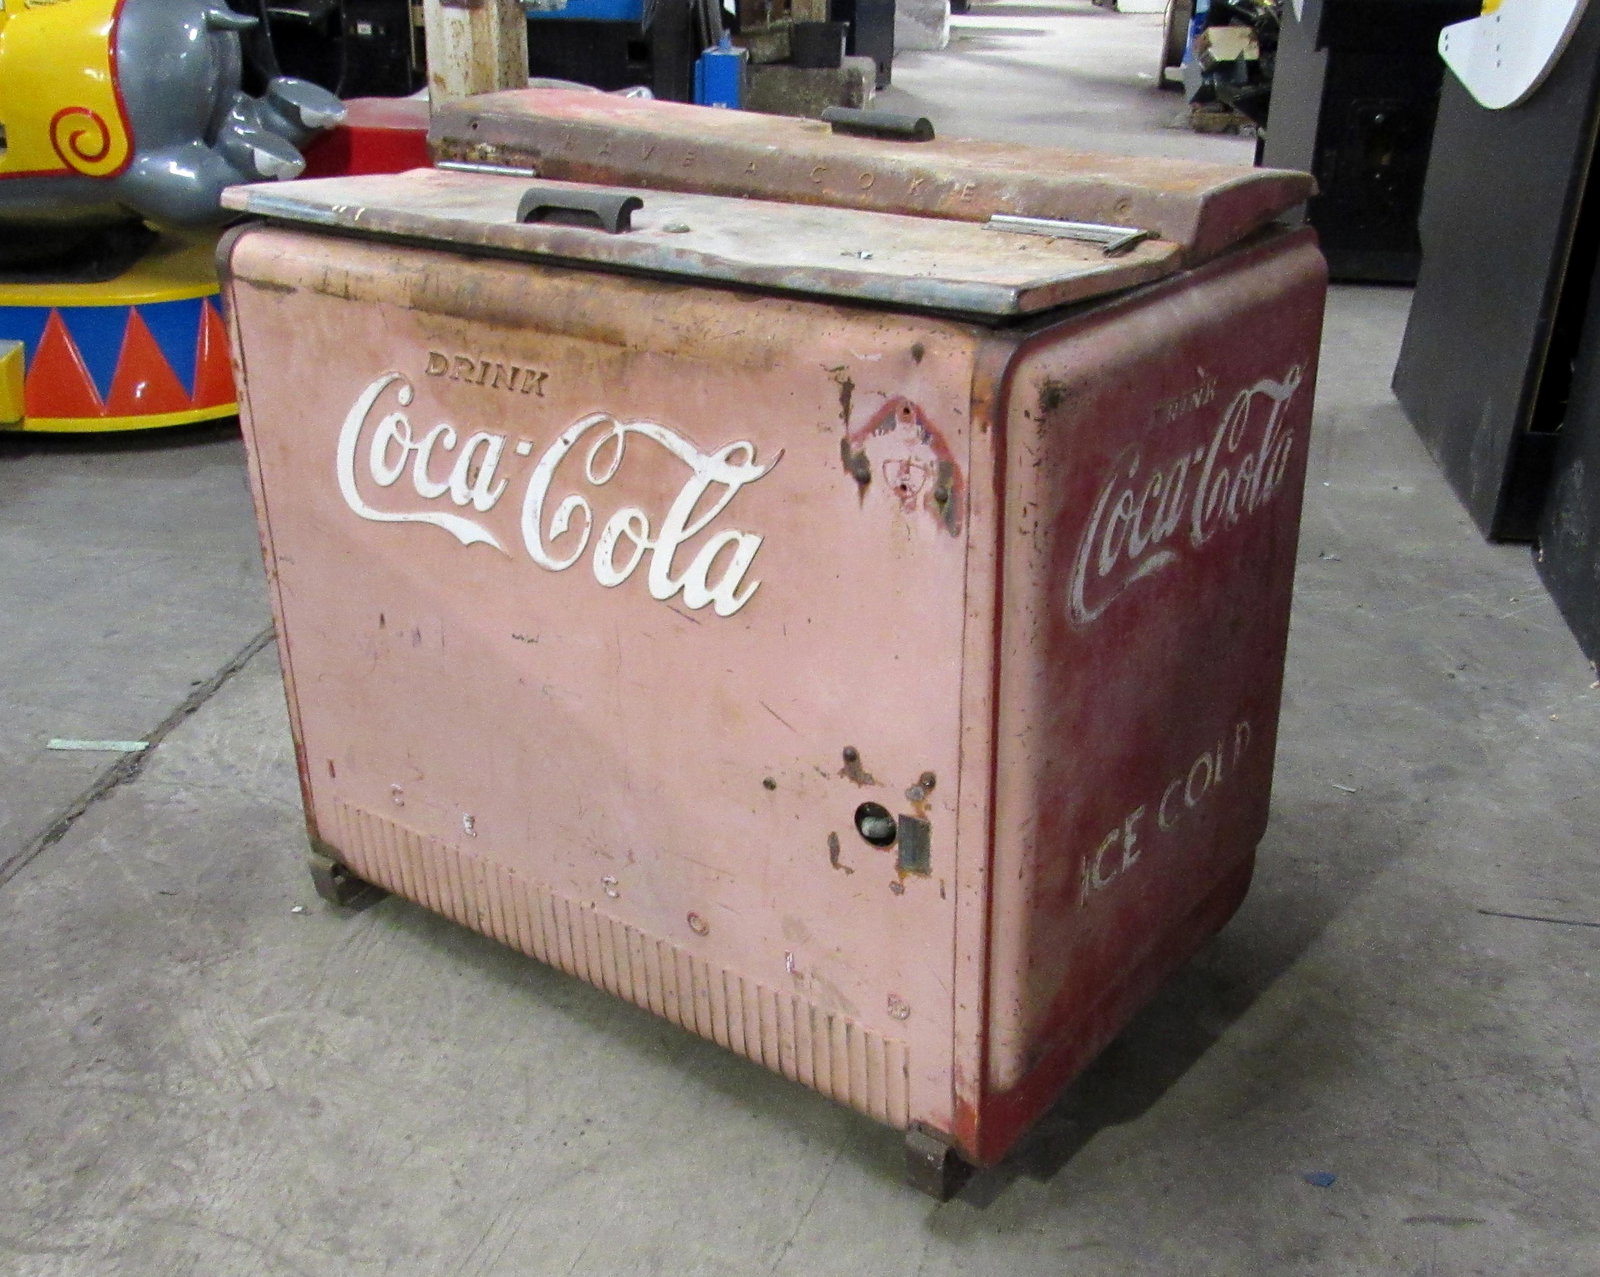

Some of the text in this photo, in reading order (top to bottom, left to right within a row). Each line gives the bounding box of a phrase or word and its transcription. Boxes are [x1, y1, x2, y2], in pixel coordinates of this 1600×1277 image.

[809, 164, 978, 203] COKE
[424, 351, 550, 398] DRINK
[337, 371, 786, 617] Coca-Cola
[1067, 362, 1306, 629] Coca-Cola
[1080, 803, 1146, 910] ICE
